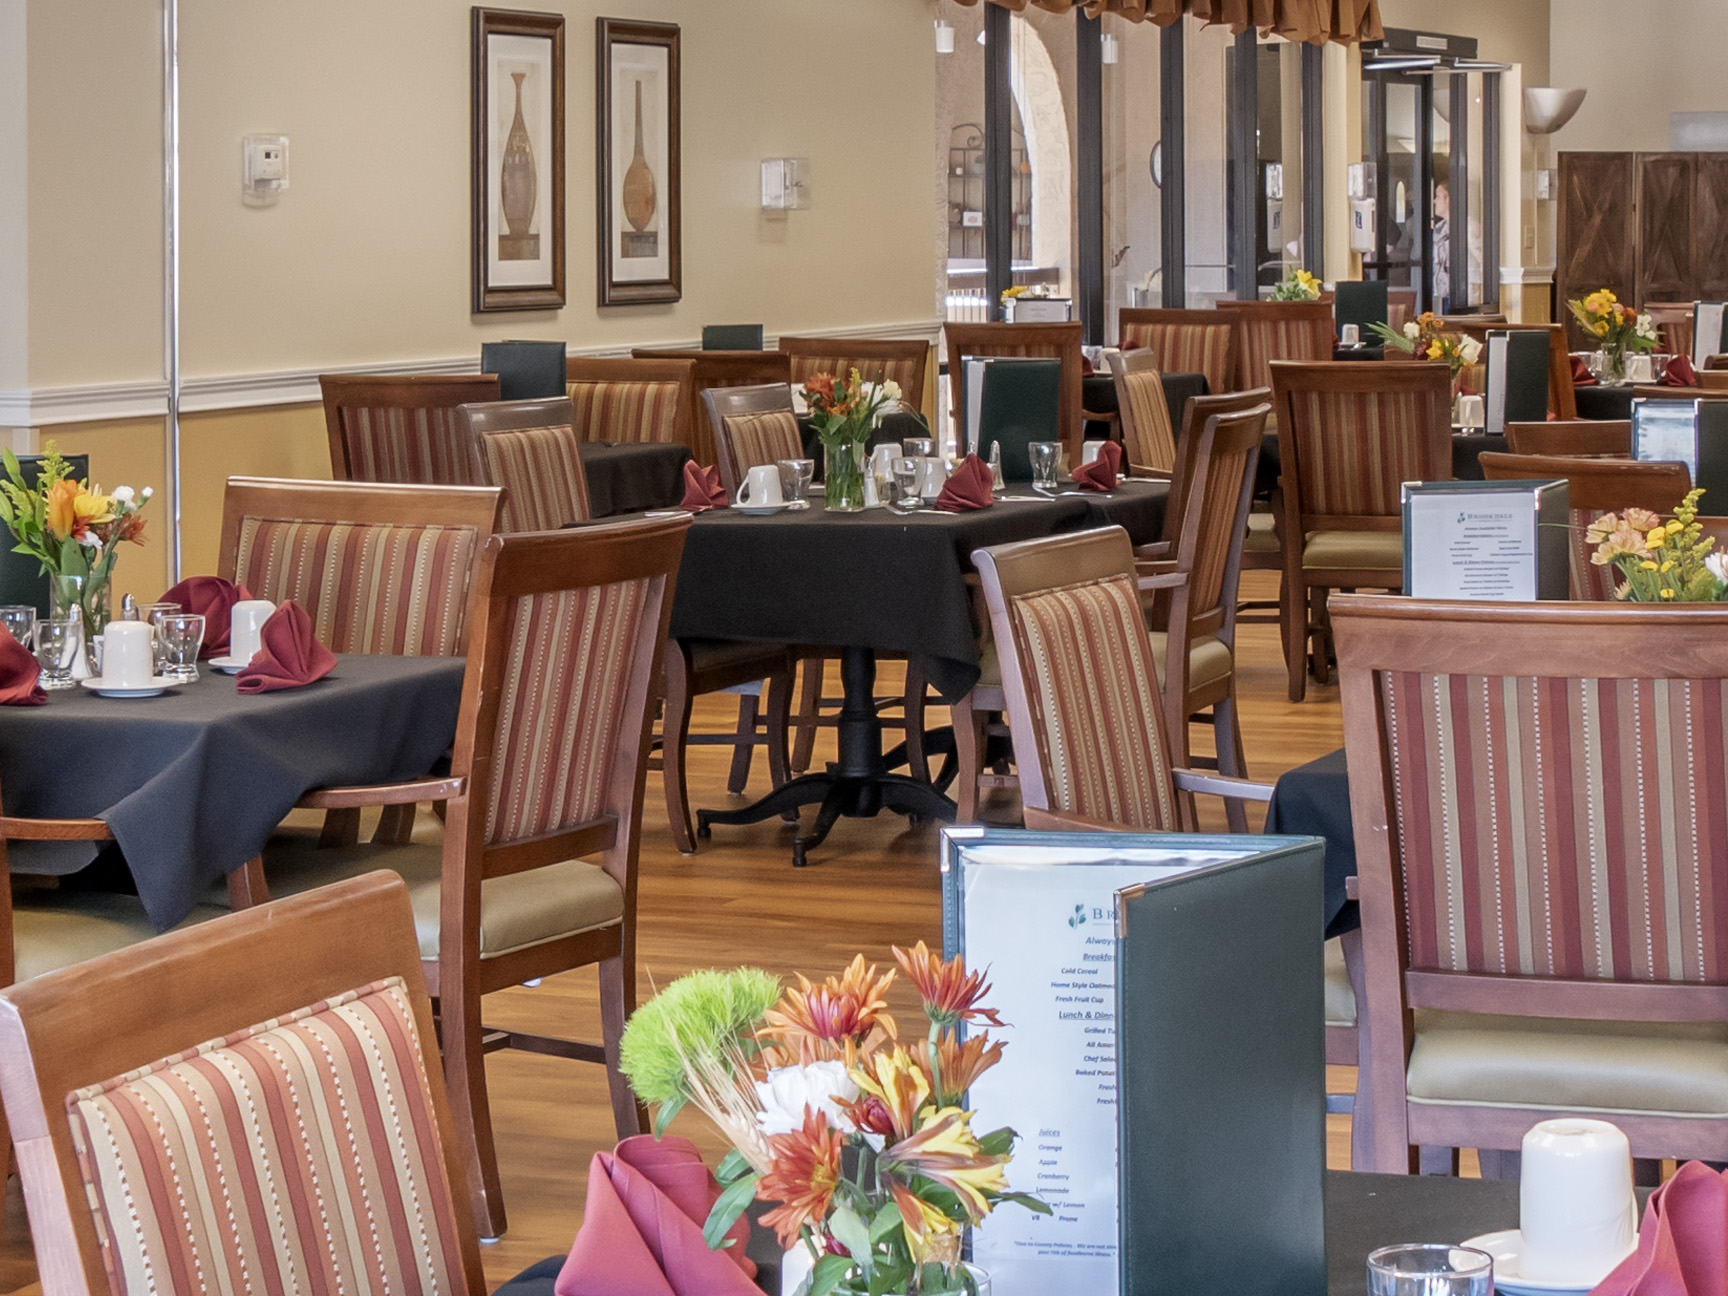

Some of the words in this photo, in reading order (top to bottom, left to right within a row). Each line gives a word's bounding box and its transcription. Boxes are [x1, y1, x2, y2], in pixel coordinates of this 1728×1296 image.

[1093, 908, 1114, 920] BR
[1059, 1011, 1083, 1019] Lunch
[1085, 1011, 1092, 1019] &
[1094, 1012, 1114, 1020] Dinn
[1083, 1055, 1099, 1063] Chef
[1039, 1129, 1060, 1137] Juices
[1037, 1173, 1070, 1181] Cranberry
